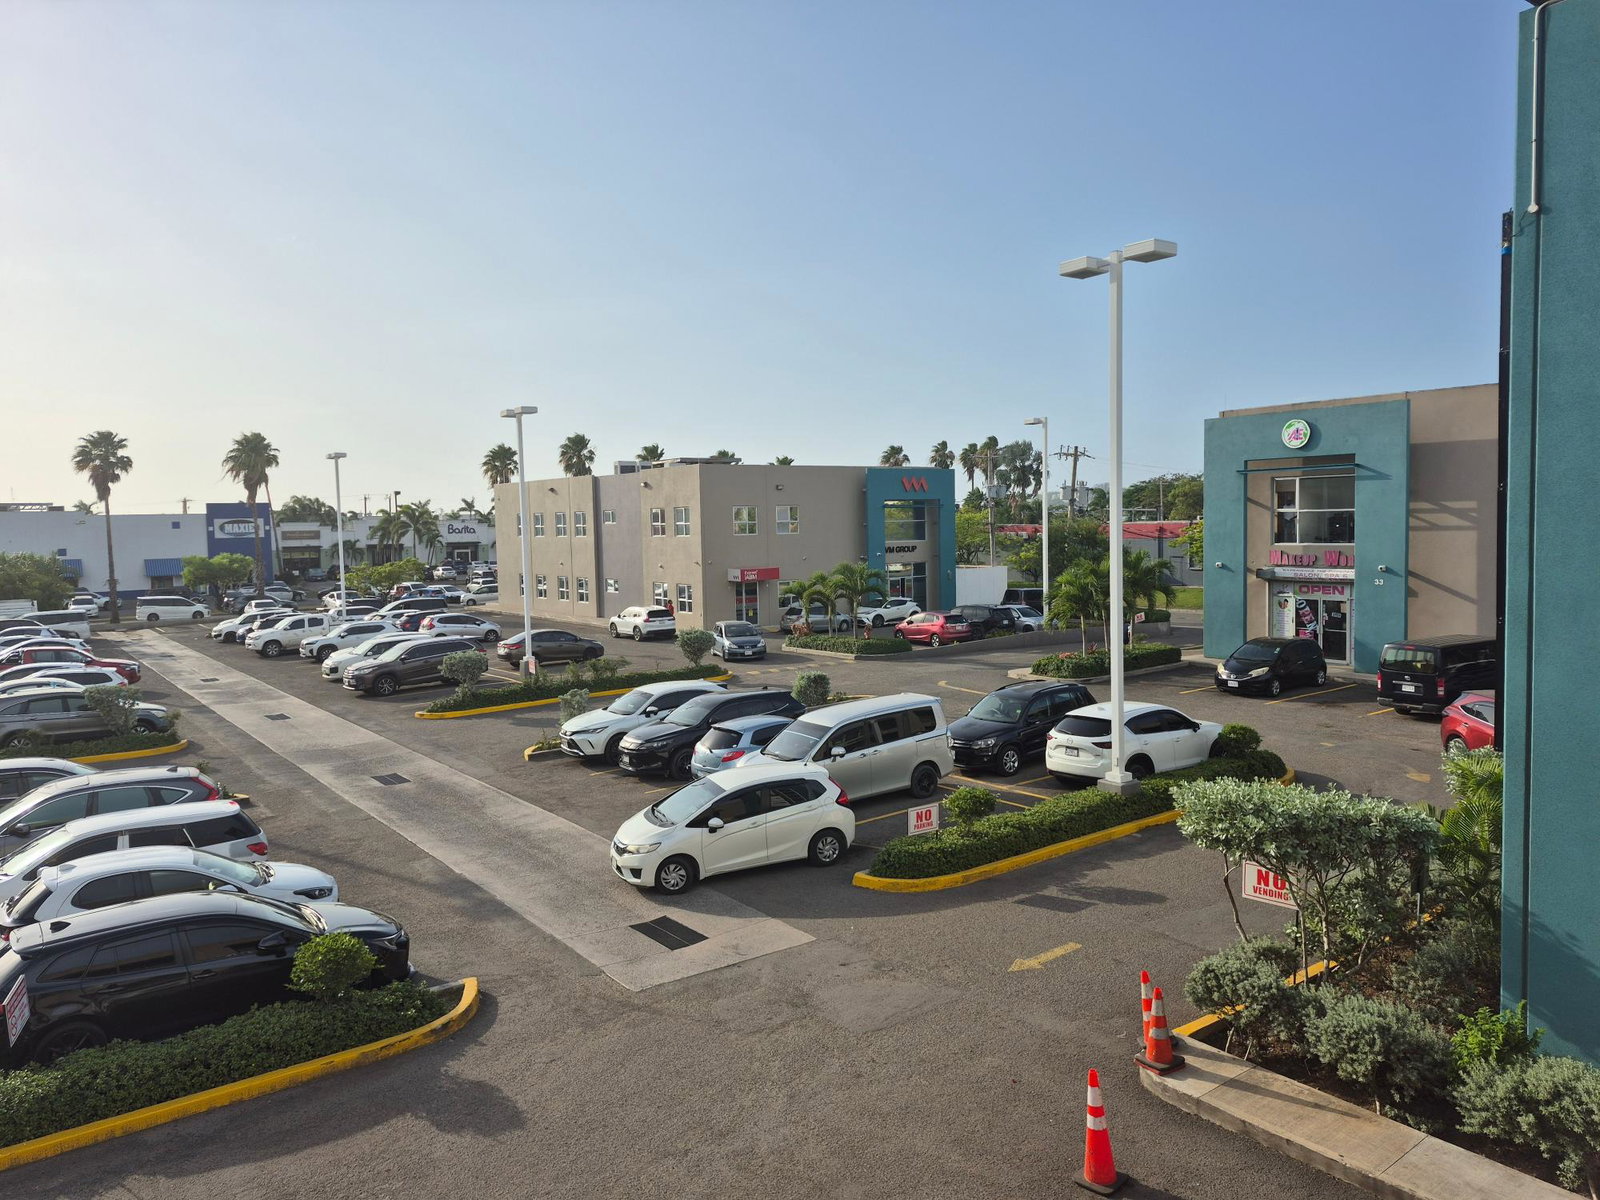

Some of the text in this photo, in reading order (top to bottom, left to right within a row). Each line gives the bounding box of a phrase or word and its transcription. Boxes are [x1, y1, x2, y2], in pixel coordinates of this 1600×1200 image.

[447, 523, 476, 534] Barita
[895, 545, 918, 553] GROUP
[1298, 585, 1345, 595] OPEN
[1296, 600, 1319, 632] OPEN
[916, 809, 931, 823] NO
[914, 821, 933, 830] PARKING
[1257, 869, 1286, 890] NO
[1253, 886, 1289, 900] VENDING
